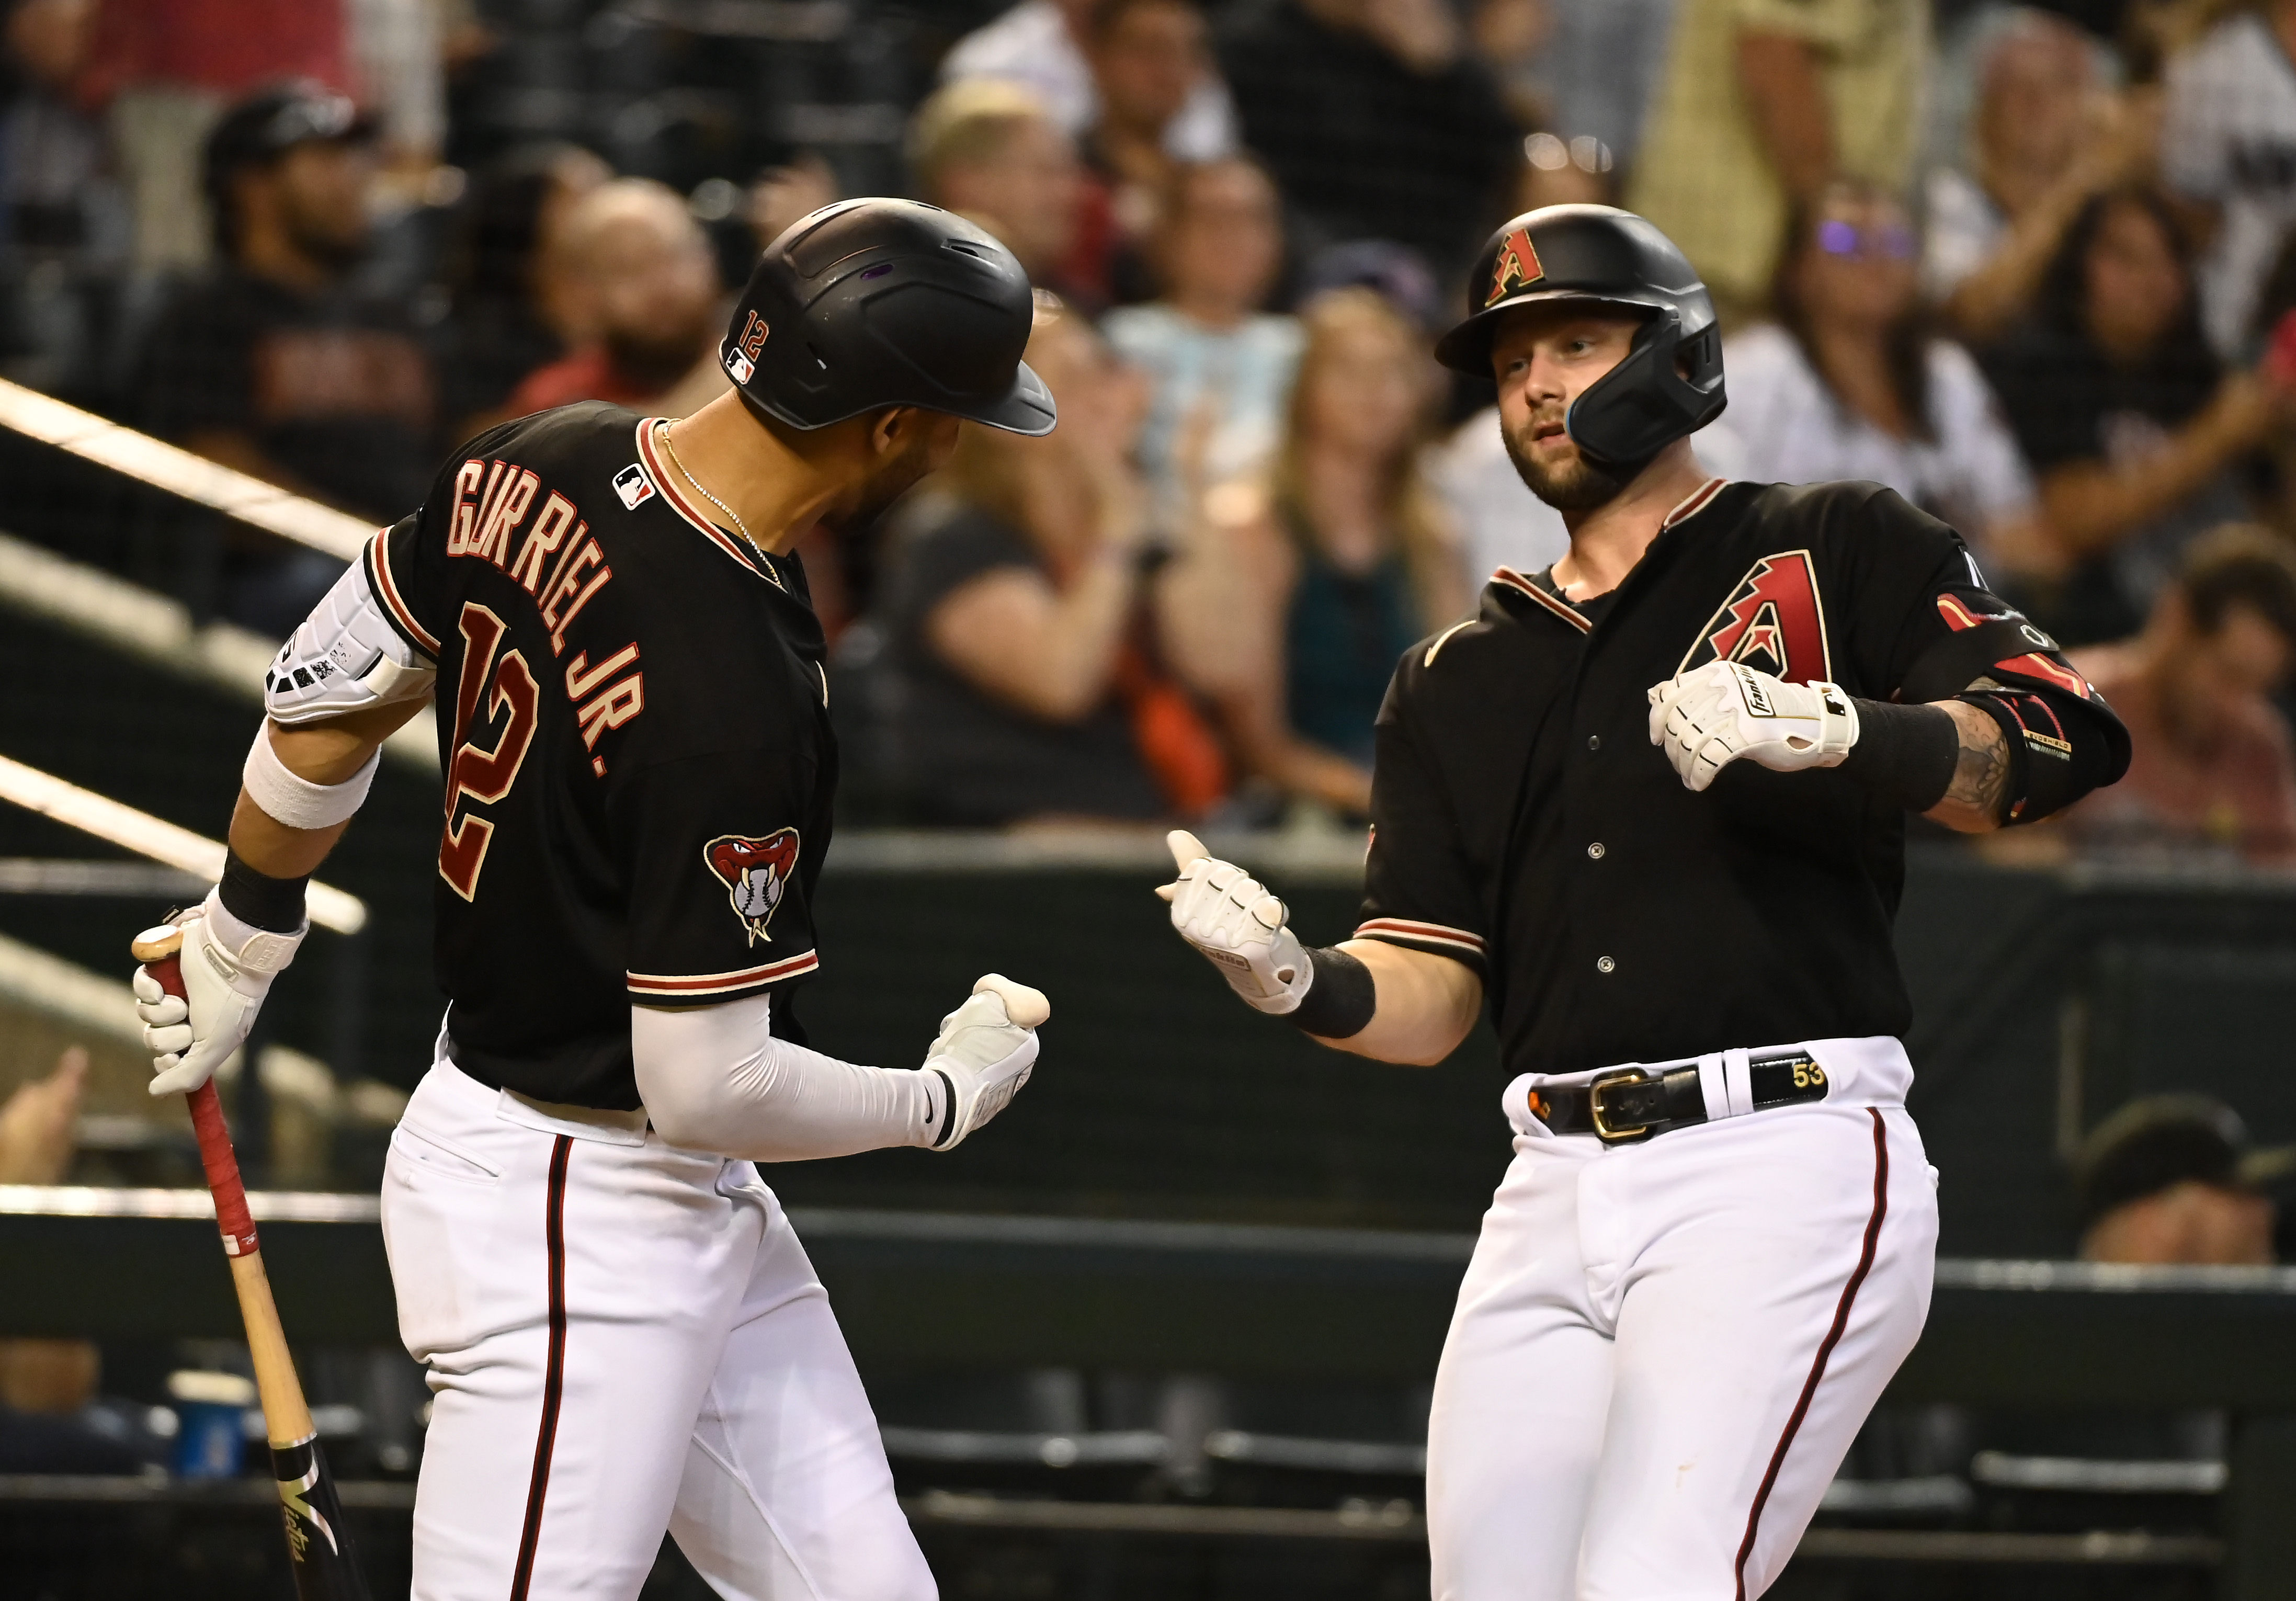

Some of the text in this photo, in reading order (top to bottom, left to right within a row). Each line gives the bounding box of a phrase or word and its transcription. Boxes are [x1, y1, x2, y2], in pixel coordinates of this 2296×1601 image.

[1485, 228, 1544, 308] A
[738, 310, 769, 362] 12
[446, 459, 644, 779] GURRIEL JR.
[1675, 549, 1832, 684] A
[438, 600, 540, 903] 12
[1793, 1062, 1826, 1087] 53
